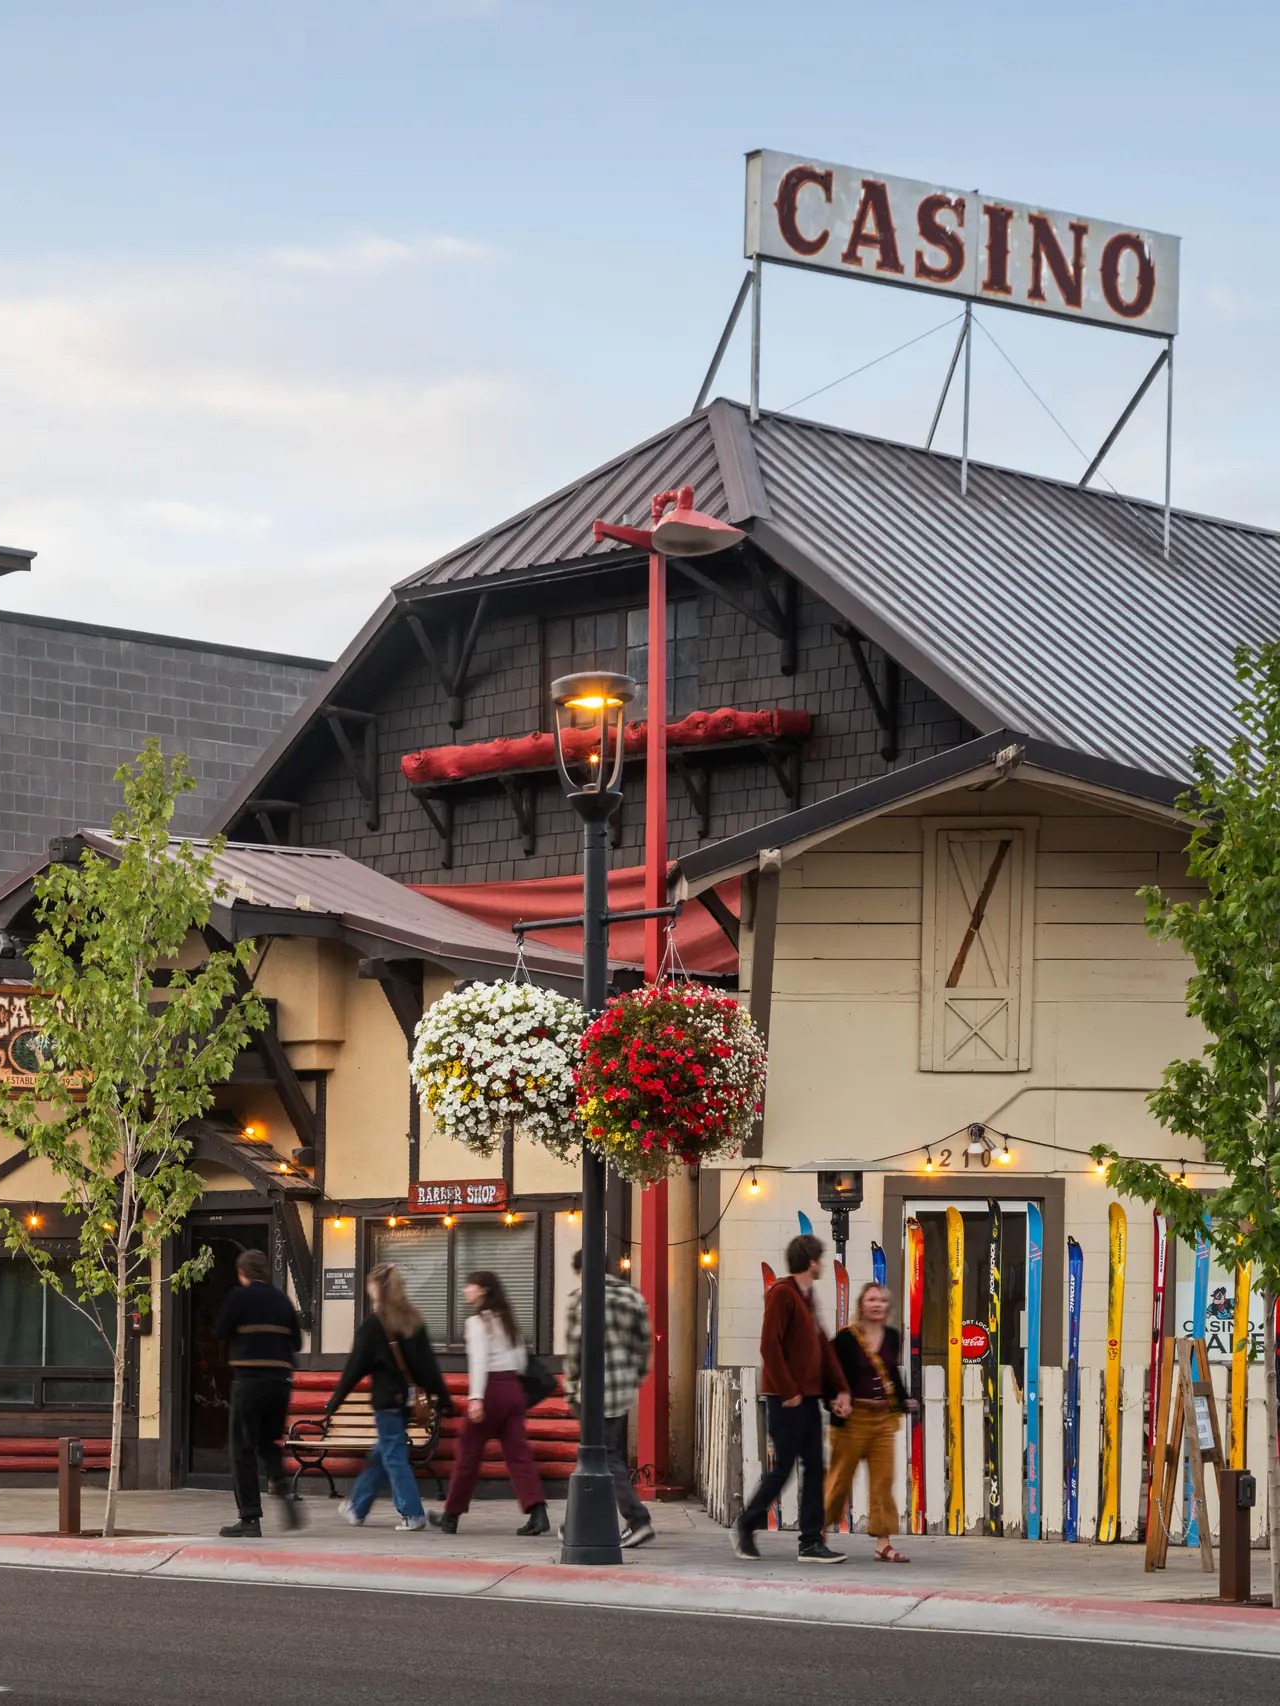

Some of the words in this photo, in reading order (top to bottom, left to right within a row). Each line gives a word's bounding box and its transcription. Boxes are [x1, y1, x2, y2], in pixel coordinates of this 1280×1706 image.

[773, 164, 1156, 318] CASINO
[939, 1149, 991, 1168] 210
[418, 1186, 463, 1206] BARBER
[467, 1185, 497, 1204] SHOP
[274, 1228, 282, 1272] 220
[1183, 1320, 1255, 1333] CSINO
